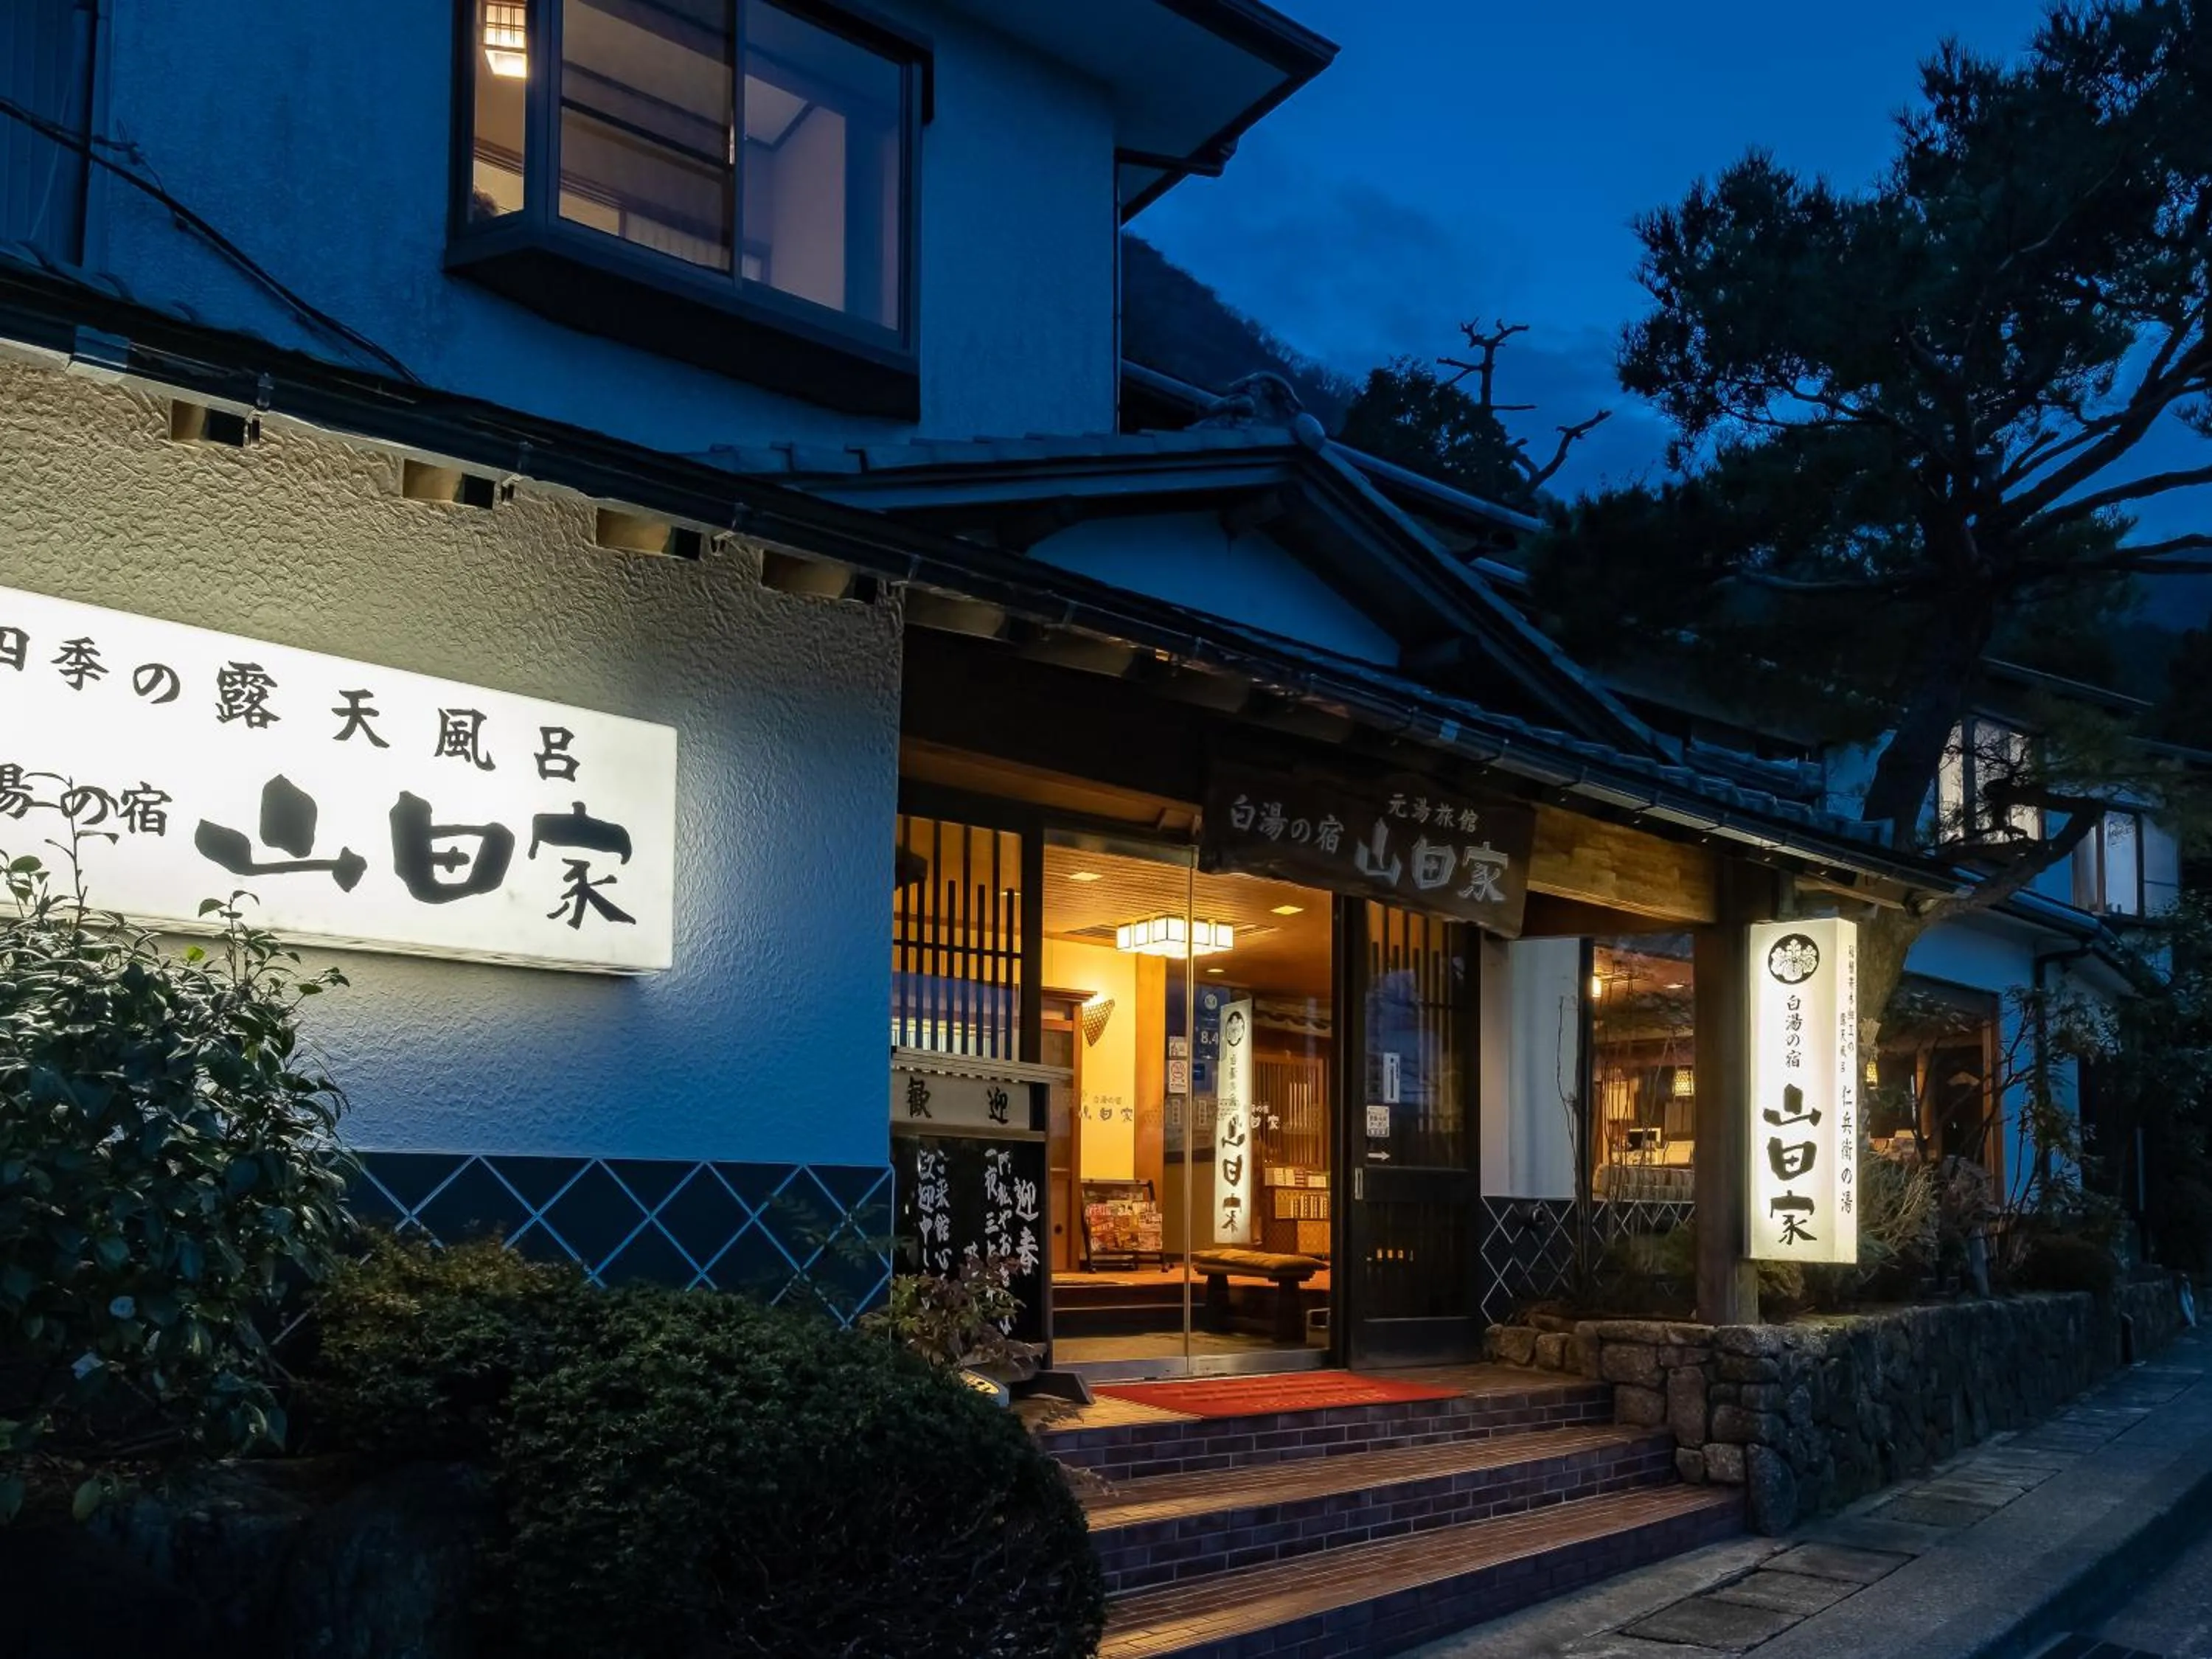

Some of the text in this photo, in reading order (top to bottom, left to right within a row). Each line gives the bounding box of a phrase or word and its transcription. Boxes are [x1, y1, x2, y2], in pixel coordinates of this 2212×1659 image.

[0, 626, 580, 783] 四季の露天風呂
[195, 774, 636, 930] 山田家
[1229, 794, 1345, 855] 白湯の宿
[1387, 793, 1479, 833] 元湯旅館
[1354, 817, 1510, 903] 山田家
[1784, 995, 1804, 1068] 白湯の宿
[1763, 1083, 1822, 1245] 山田家
[1015, 1176, 1039, 1277] 迎春
